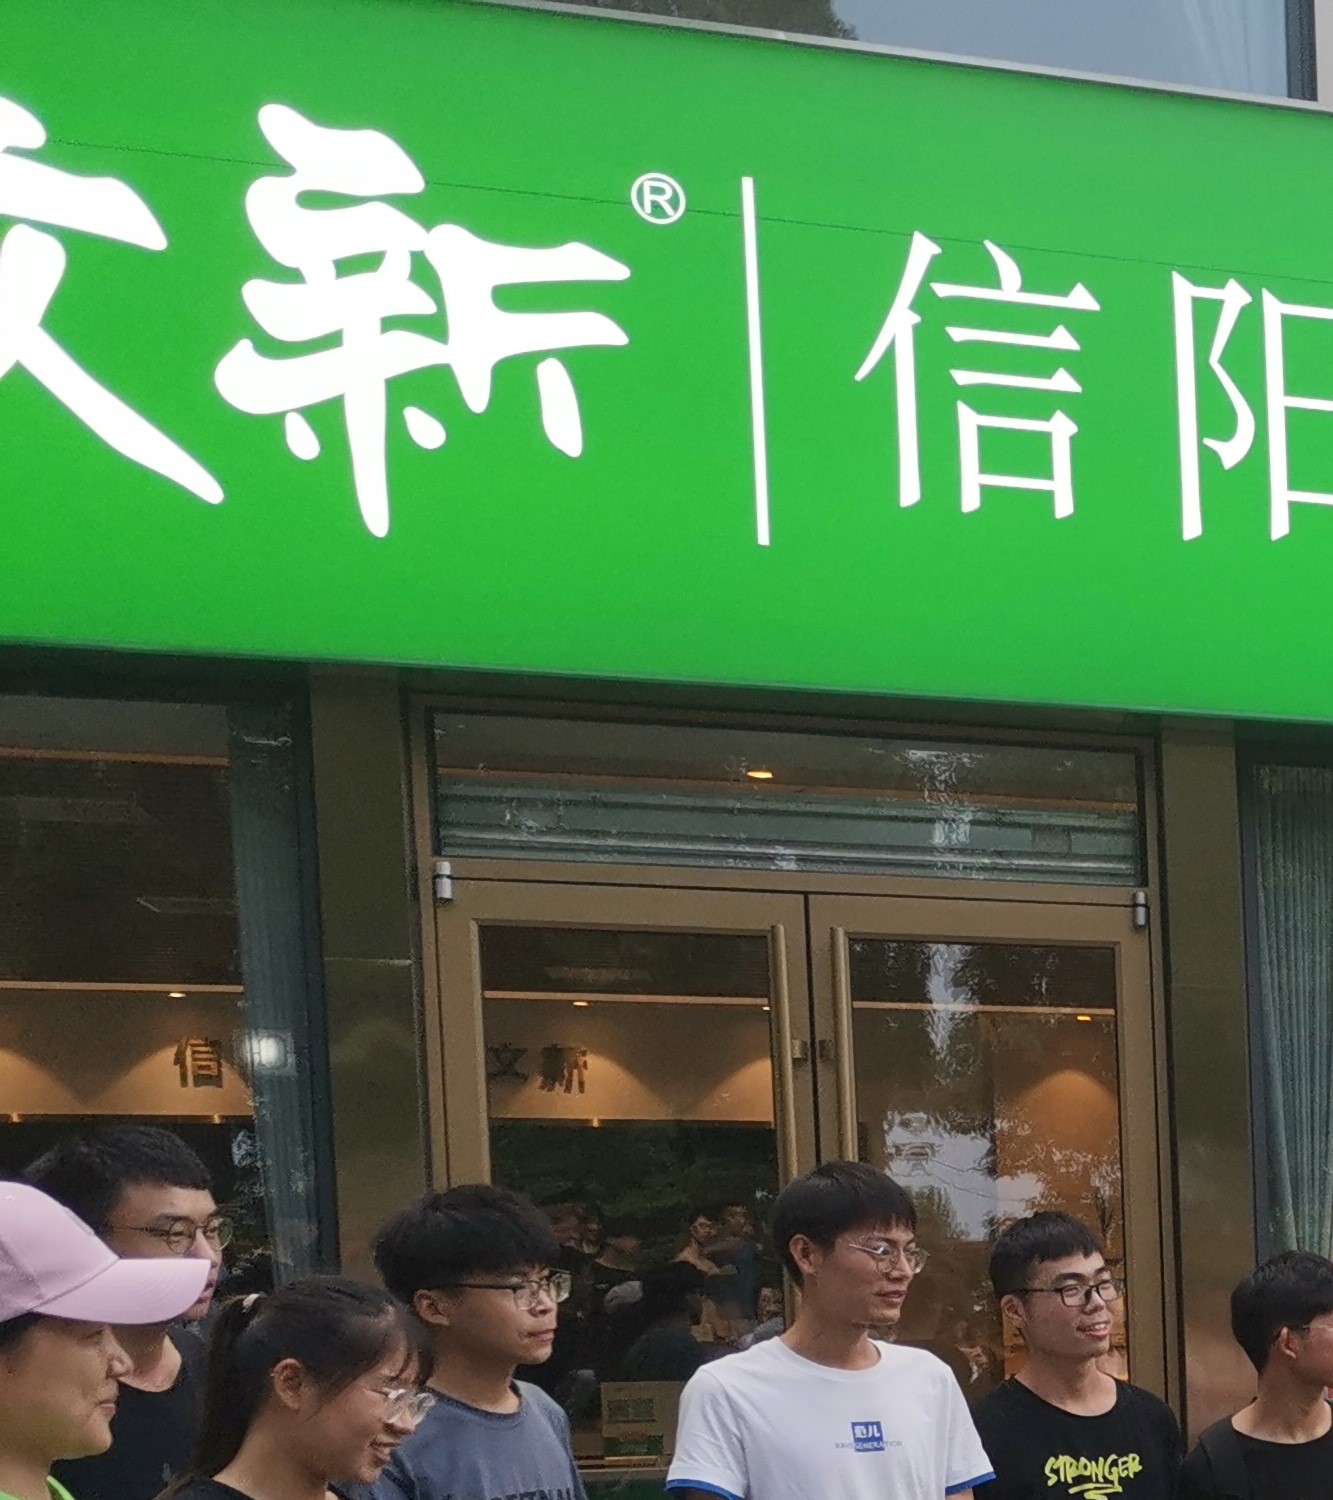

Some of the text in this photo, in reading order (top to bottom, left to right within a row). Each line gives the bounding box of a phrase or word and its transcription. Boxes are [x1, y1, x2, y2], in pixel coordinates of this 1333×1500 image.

[172, 1036, 224, 1089] 信
[486, 1041, 588, 1094] 文新
[1044, 1452, 1143, 1487] STRONGER
